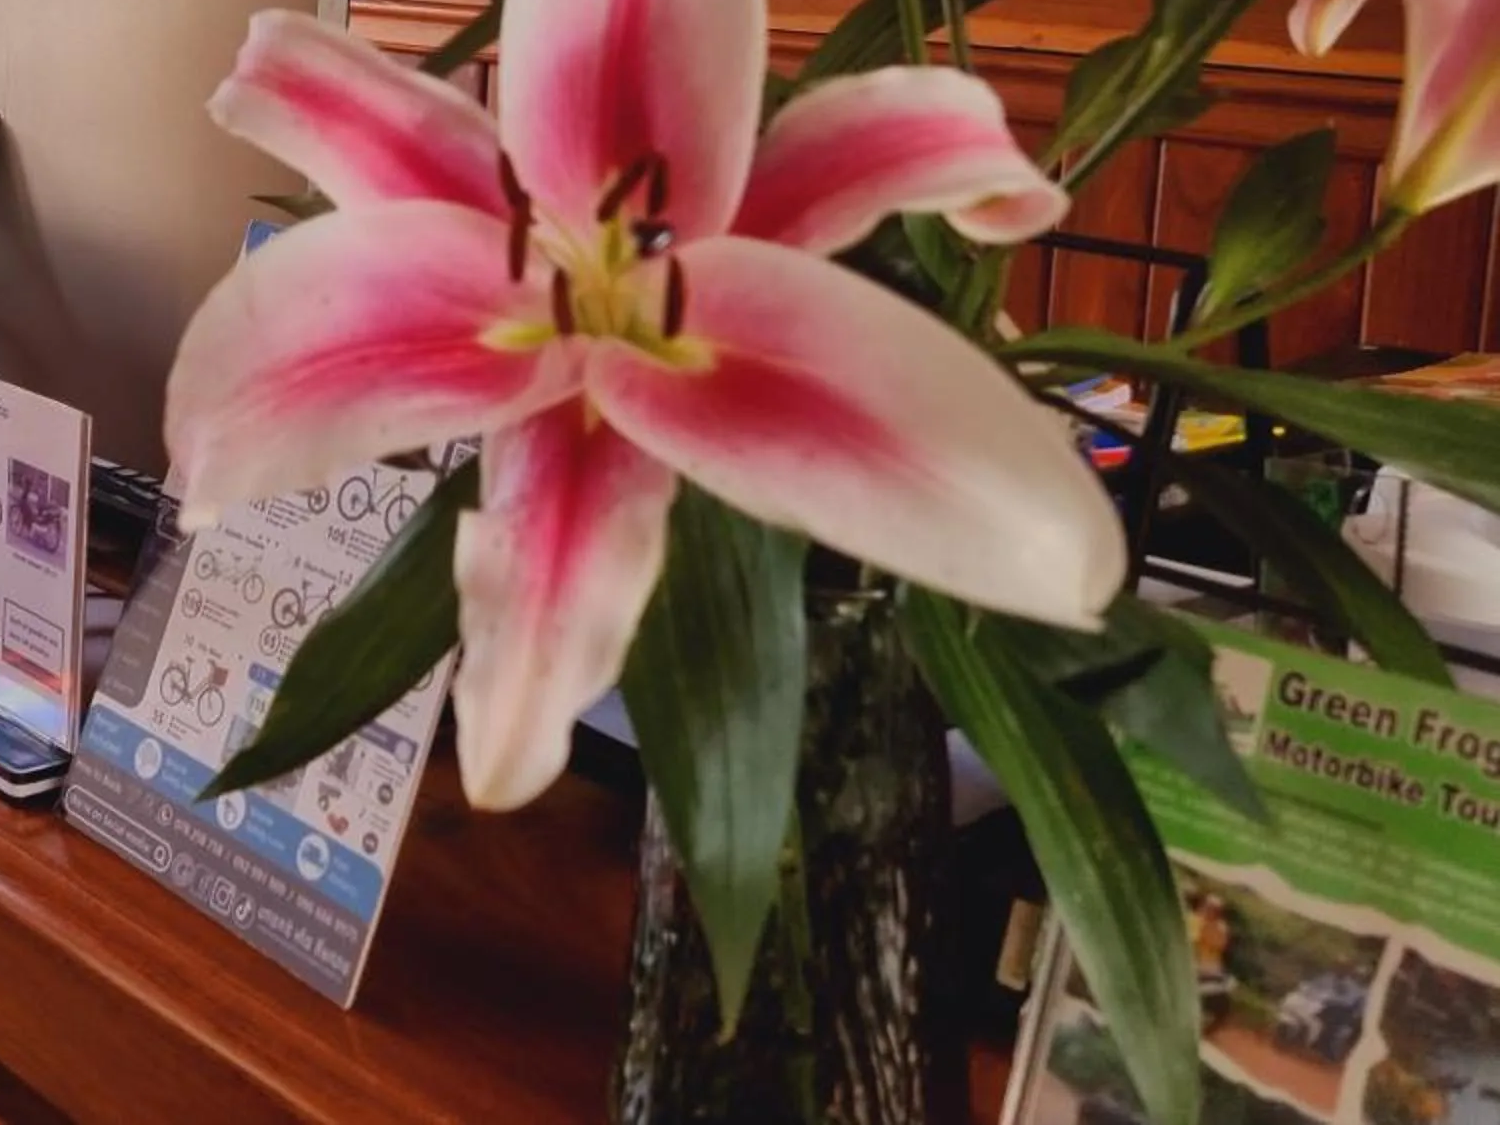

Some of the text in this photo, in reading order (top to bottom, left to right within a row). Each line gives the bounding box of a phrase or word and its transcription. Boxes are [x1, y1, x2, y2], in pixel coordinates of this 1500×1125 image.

[1265, 730, 1424, 803] Motorbike
[1279, 671, 1500, 780] Green Frog
